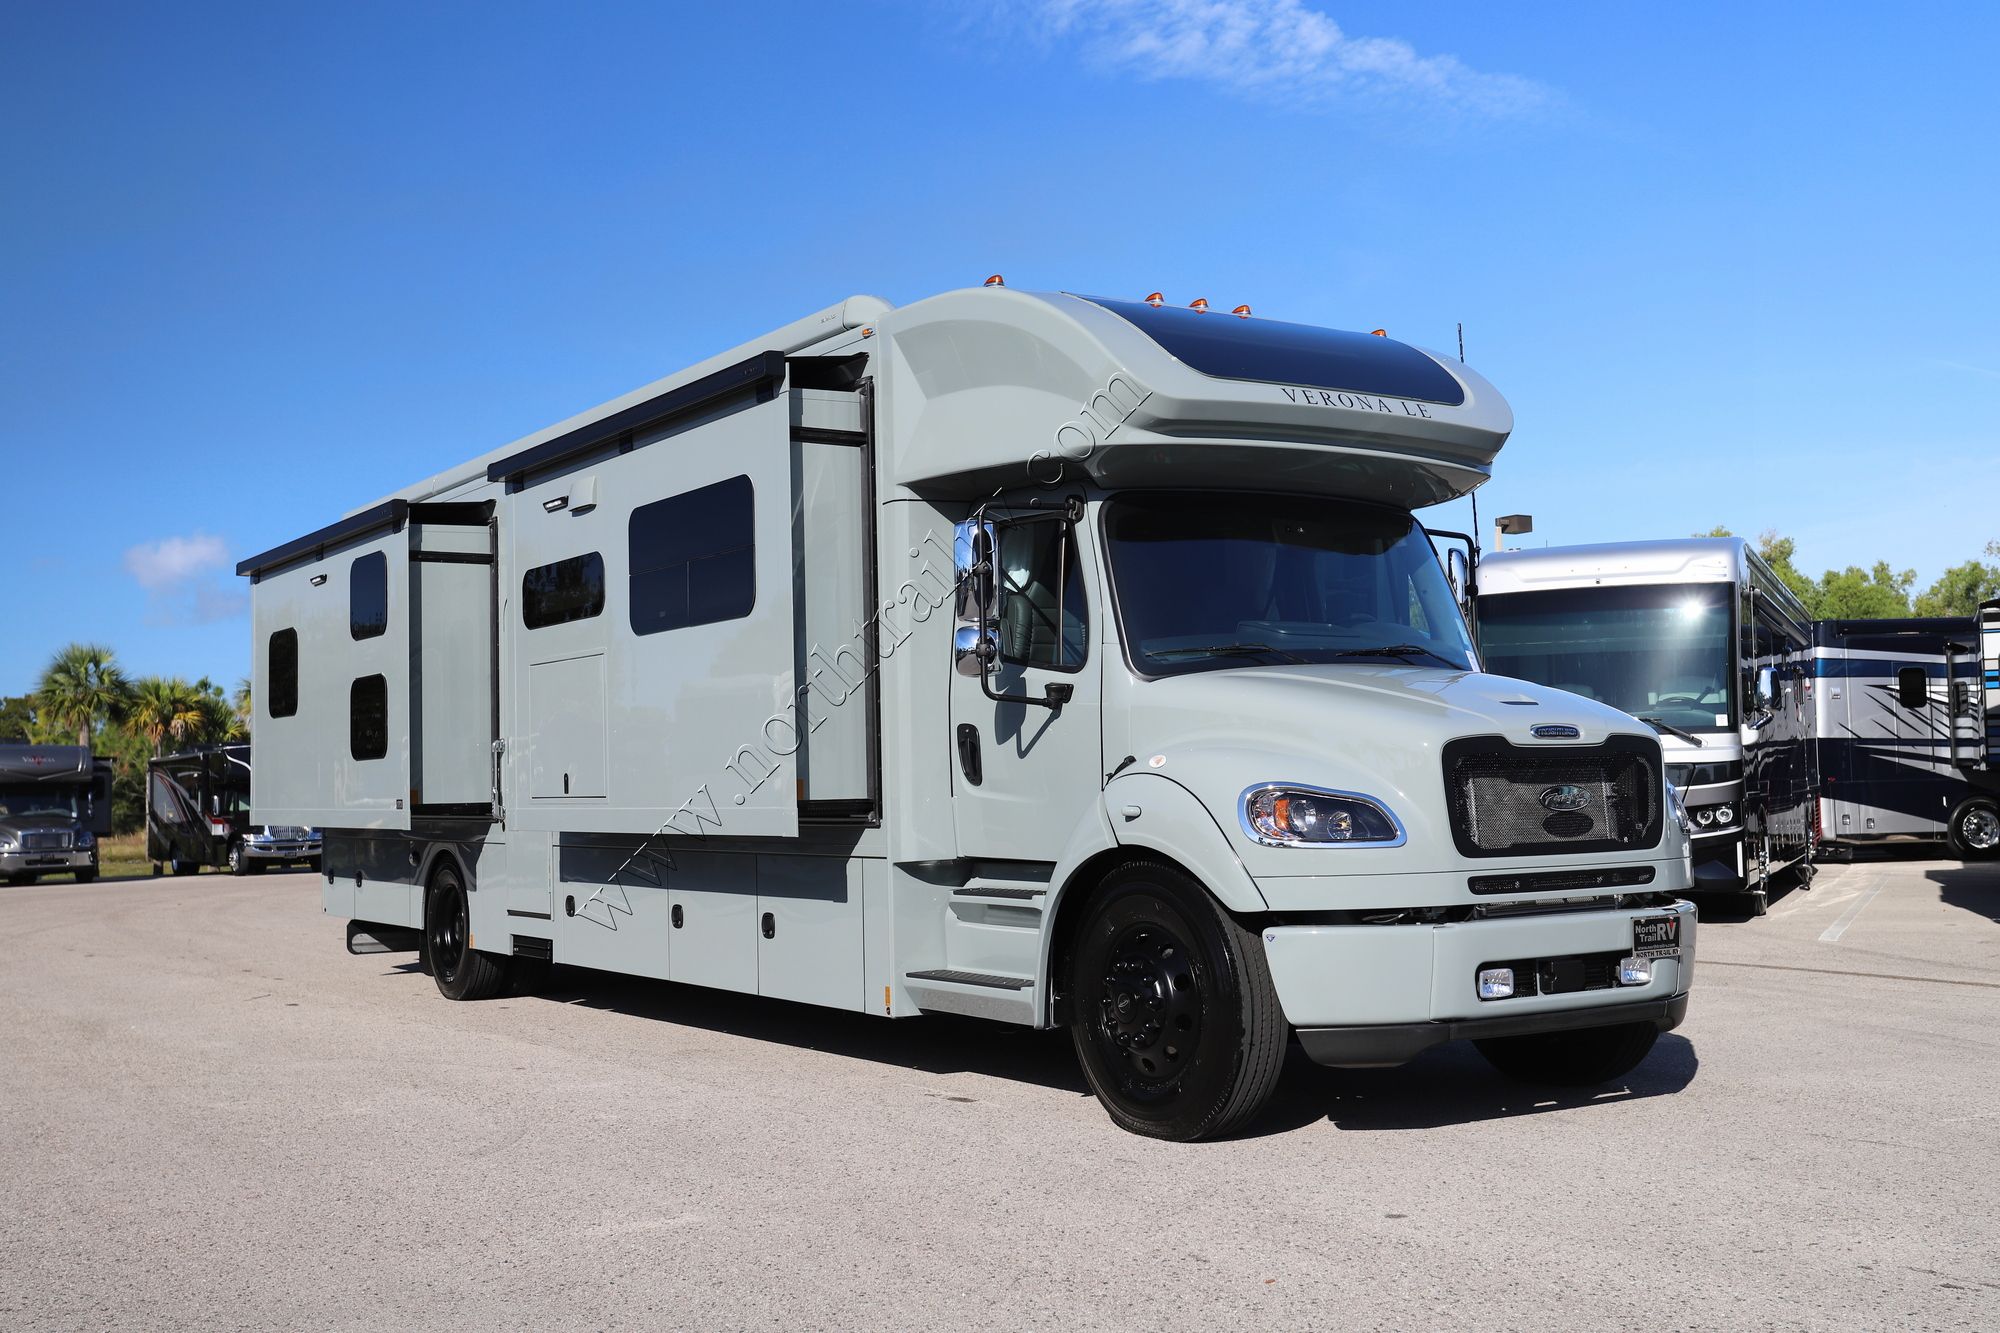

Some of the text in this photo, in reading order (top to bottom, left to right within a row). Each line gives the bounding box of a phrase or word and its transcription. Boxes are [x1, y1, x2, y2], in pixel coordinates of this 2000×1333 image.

[1280, 387, 1432, 419] VERONA LE
[1635, 924, 1657, 934] North
[1657, 922, 1676, 941] RV
[1639, 933, 1657, 942] Trail
[1635, 950, 1655, 958] NORTH
[1656, 949, 1671, 957] TRAIL
